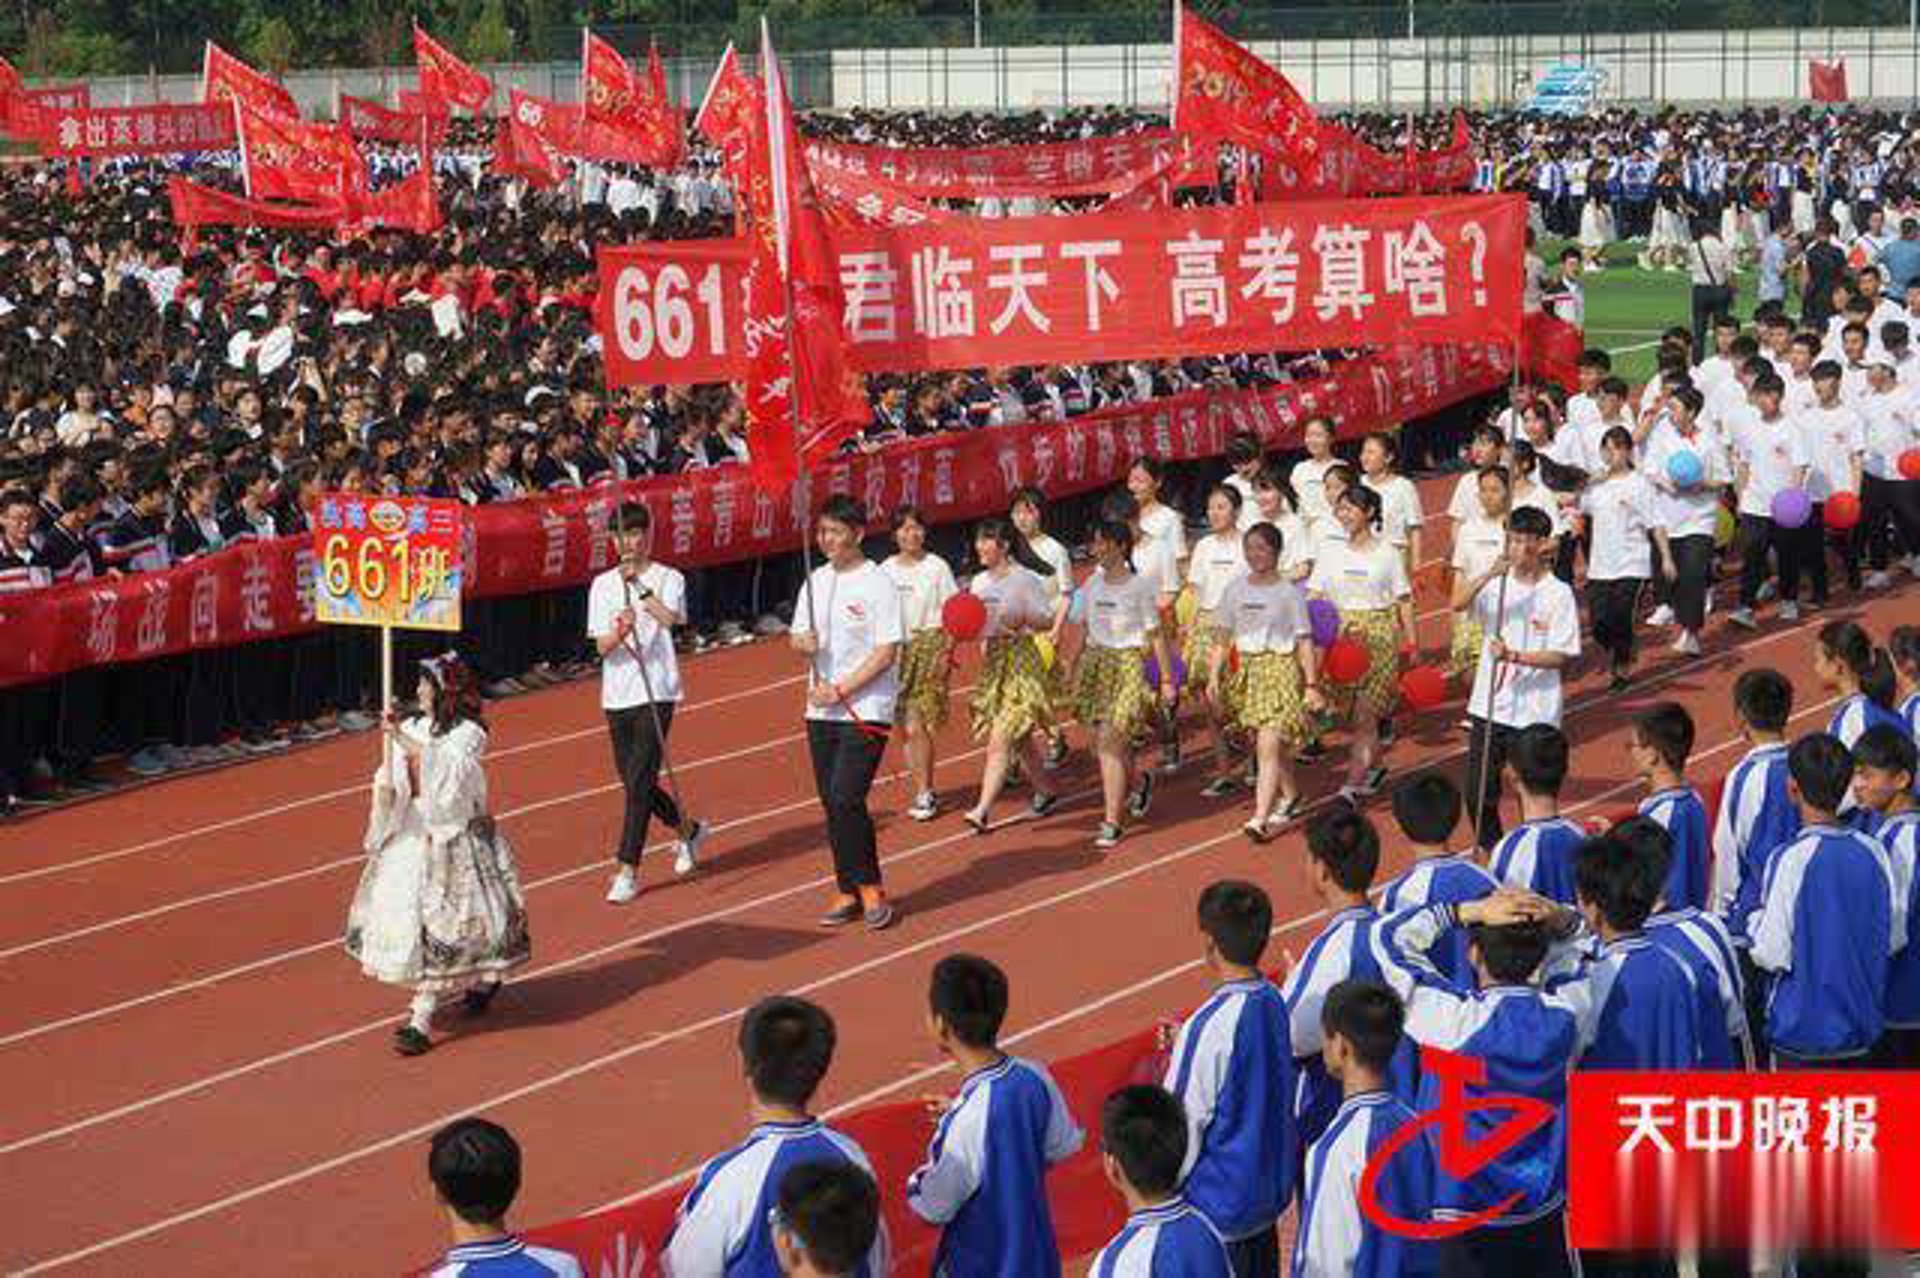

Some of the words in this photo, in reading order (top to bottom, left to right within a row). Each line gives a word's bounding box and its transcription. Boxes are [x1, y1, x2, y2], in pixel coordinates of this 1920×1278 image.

[614, 263, 726, 361] 661
[838, 239, 1123, 344] 君临天下
[1166, 219, 1488, 329] 高考算啥？
[323, 532, 451, 602] 661班
